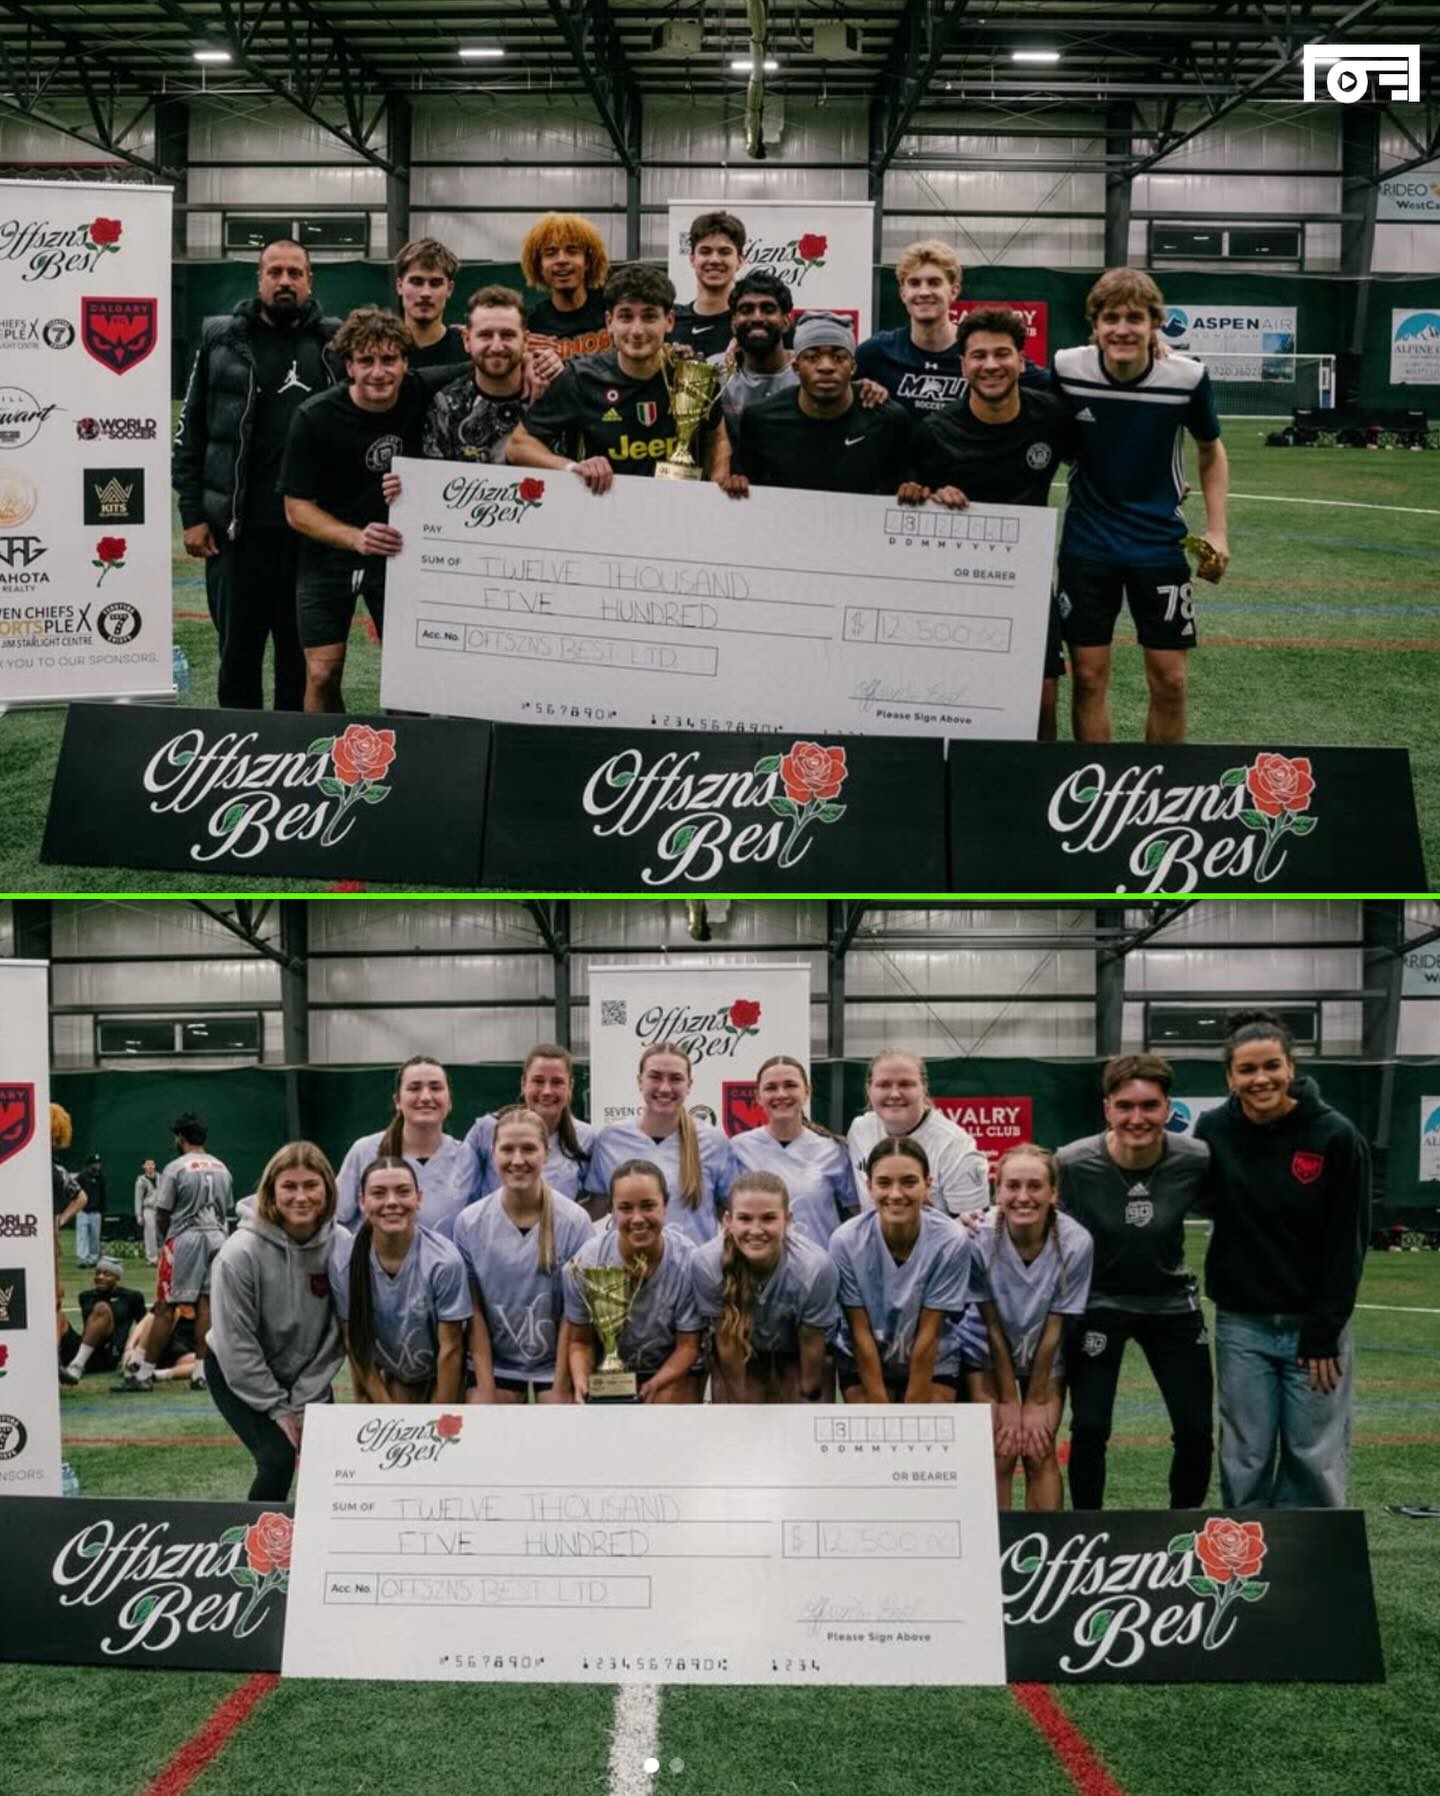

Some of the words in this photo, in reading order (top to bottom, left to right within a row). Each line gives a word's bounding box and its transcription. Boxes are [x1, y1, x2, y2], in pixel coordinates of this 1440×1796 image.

[1380, 183, 1428, 197] RIDEO
[1193, 318, 1259, 330] ASPEN
[1262, 318, 1293, 331] AIR
[99, 417, 157, 430] WORLD
[108, 429, 157, 440] SOCCER
[442, 475, 520, 509] Offszns
[101, 503, 128, 513] KITS
[464, 501, 529, 529] Best
[422, 523, 442, 535] PAY
[420, 554, 444, 565] SUM
[447, 556, 461, 567] OF
[479, 556, 581, 586] TWELVE
[601, 561, 750, 600] THOUSAND
[953, 567, 970, 578] OR
[973, 569, 1016, 581] BEARER
[2, 584, 37, 593] REALTY
[24, 604, 75, 620] CHIEFS
[482, 587, 555, 616] FIVE
[600, 595, 719, 630] HUNDRED
[1156, 581, 1196, 622] 78
[62, 635, 93, 647] CENTRE
[8, 657, 34, 669] YOU
[38, 656, 55, 668] TO
[58, 654, 86, 667] OUR
[876, 708, 911, 721] Please
[914, 711, 937, 725] Sign
[939, 713, 972, 725] Above
[143, 728, 333, 814] Offszns
[582, 748, 780, 837] Offszns
[1047, 763, 1247, 854] Offszns
[190, 789, 356, 862] Best
[640, 810, 814, 886] Best
[1115, 824, 1288, 894] Best
[635, 1005, 728, 1048] Offszns
[604, 1106, 635, 1118] SEVEN
[986, 1126, 1022, 1137] CLUB
[357, 1417, 438, 1452] Offszns
[379, 1443, 446, 1470] Best
[335, 1469, 356, 1479] PAY
[892, 1471, 909, 1482] OR
[912, 1471, 958, 1482] BEARER
[332, 1502, 356, 1512] SUM
[360, 1502, 375, 1512] OF
[392, 1497, 502, 1521] TWELVE
[522, 1493, 681, 1523] THOUSAND
[399, 1531, 477, 1556] FIVE
[524, 1529, 651, 1557] HUNDRED
[53, 1519, 245, 1607] Offszns
[1000, 1532, 1195, 1625] Offszns
[101, 1581, 270, 1655] Best
[827, 1632, 865, 1642] Please
[868, 1632, 893, 1644] Sign
[896, 1632, 932, 1642] Above
[1059, 1593, 1238, 1674] Best
[772, 1659, 821, 1672] 1234
